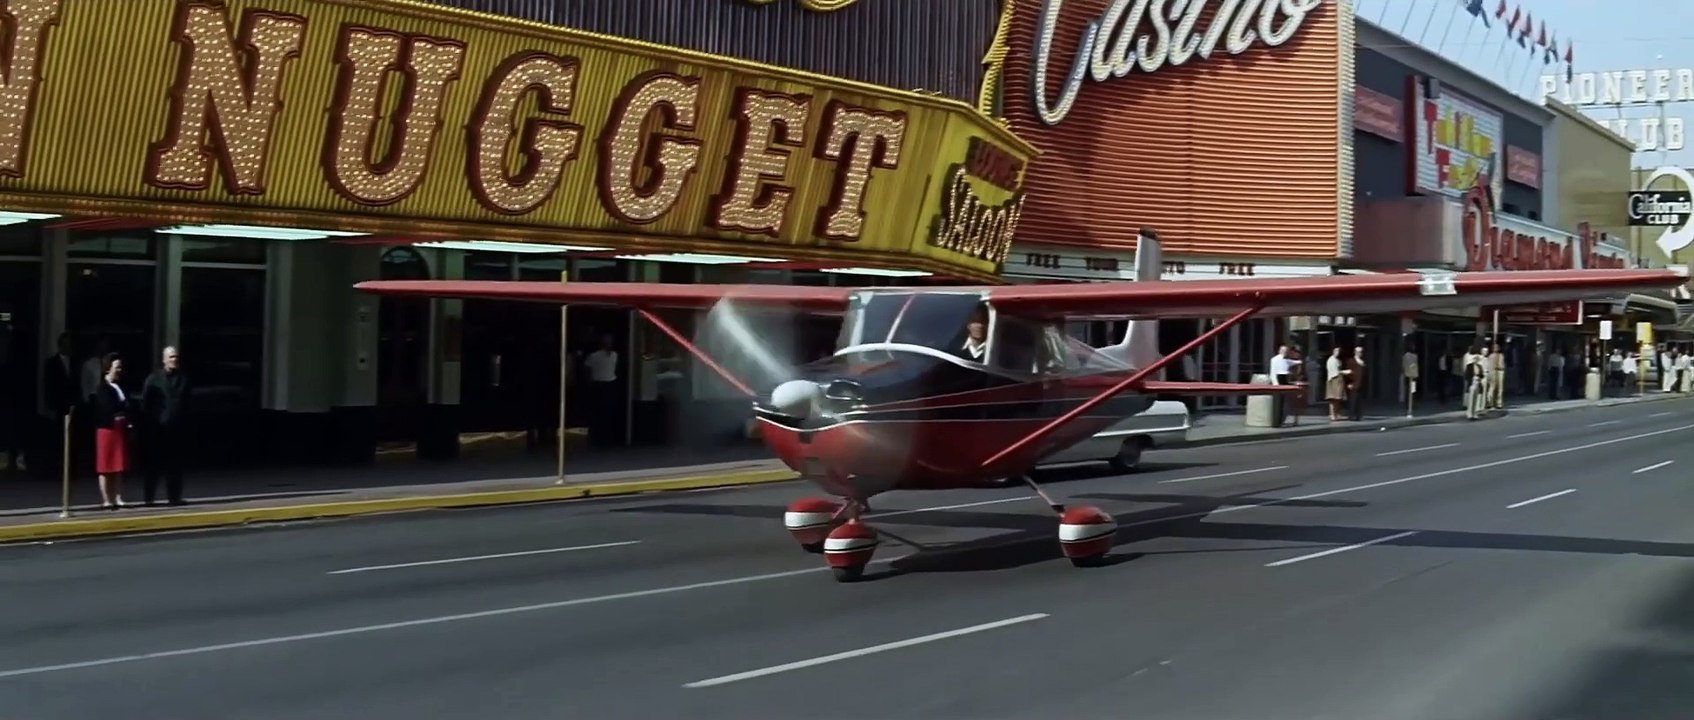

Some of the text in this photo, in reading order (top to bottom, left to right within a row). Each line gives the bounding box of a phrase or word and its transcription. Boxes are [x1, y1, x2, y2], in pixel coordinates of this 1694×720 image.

[1034, 0, 1322, 125] Casino
[1540, 69, 1694, 106] PIONEER
[147, 2, 906, 241] NUGGET
[937, 167, 1027, 263] SALOON
[1628, 193, 1691, 219] California
[1647, 214, 1679, 224] CLUB
